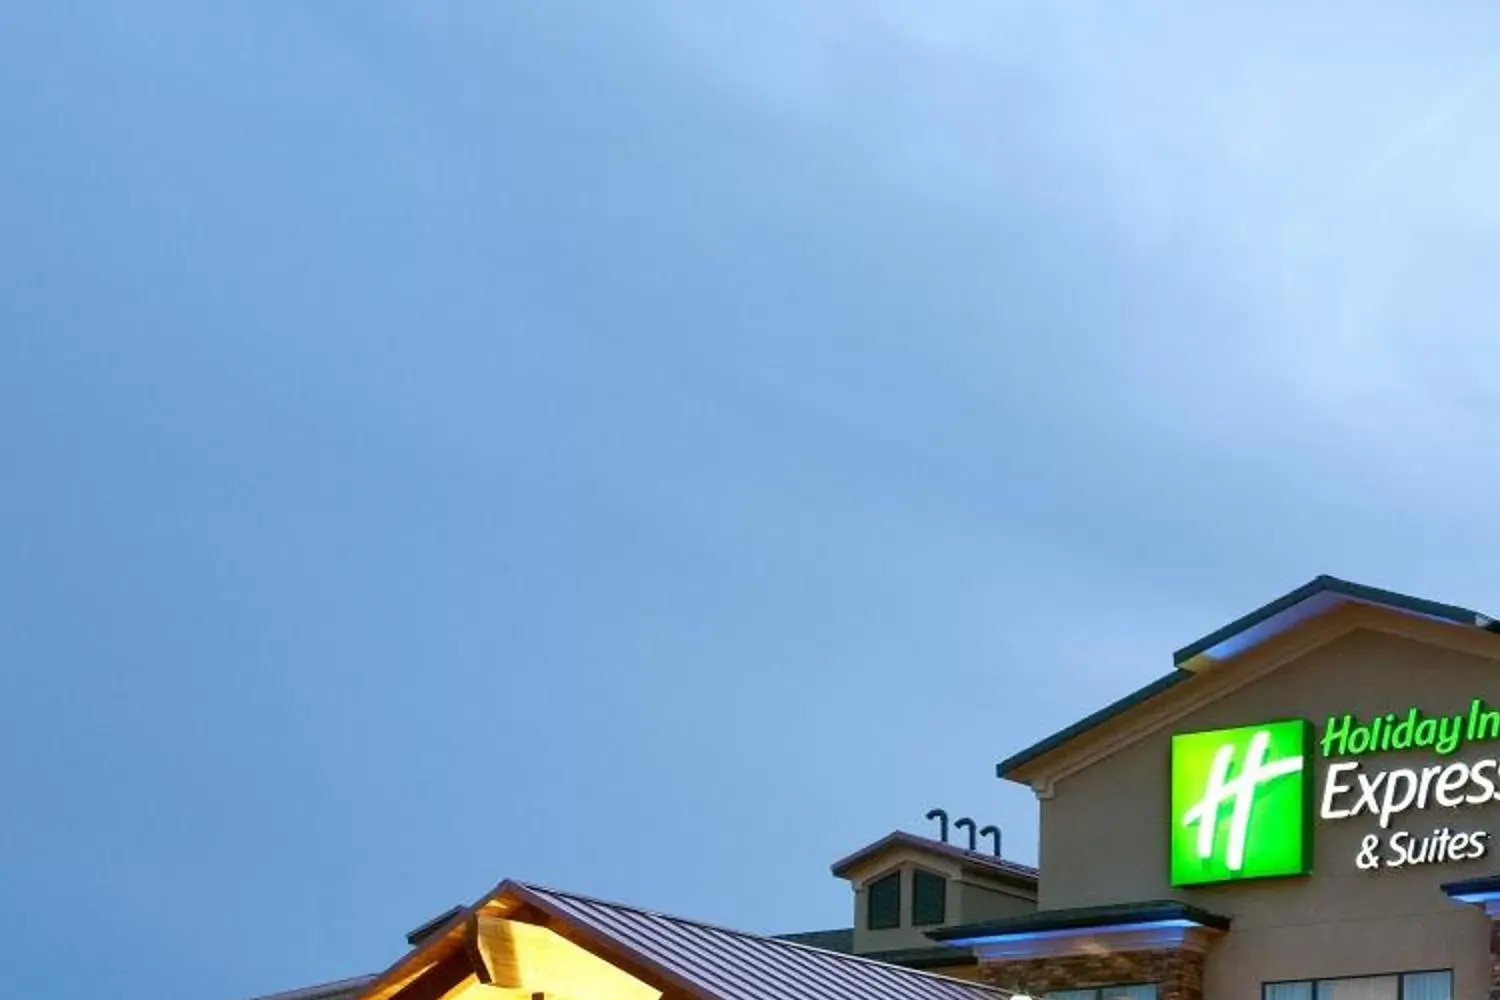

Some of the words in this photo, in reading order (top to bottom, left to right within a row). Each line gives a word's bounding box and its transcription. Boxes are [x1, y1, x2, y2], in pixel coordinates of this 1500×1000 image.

[1320, 708, 1462, 757] Holiday
[1182, 730, 1304, 871] H
[1355, 834, 1379, 869] &
[1386, 829, 1486, 867] Suites
